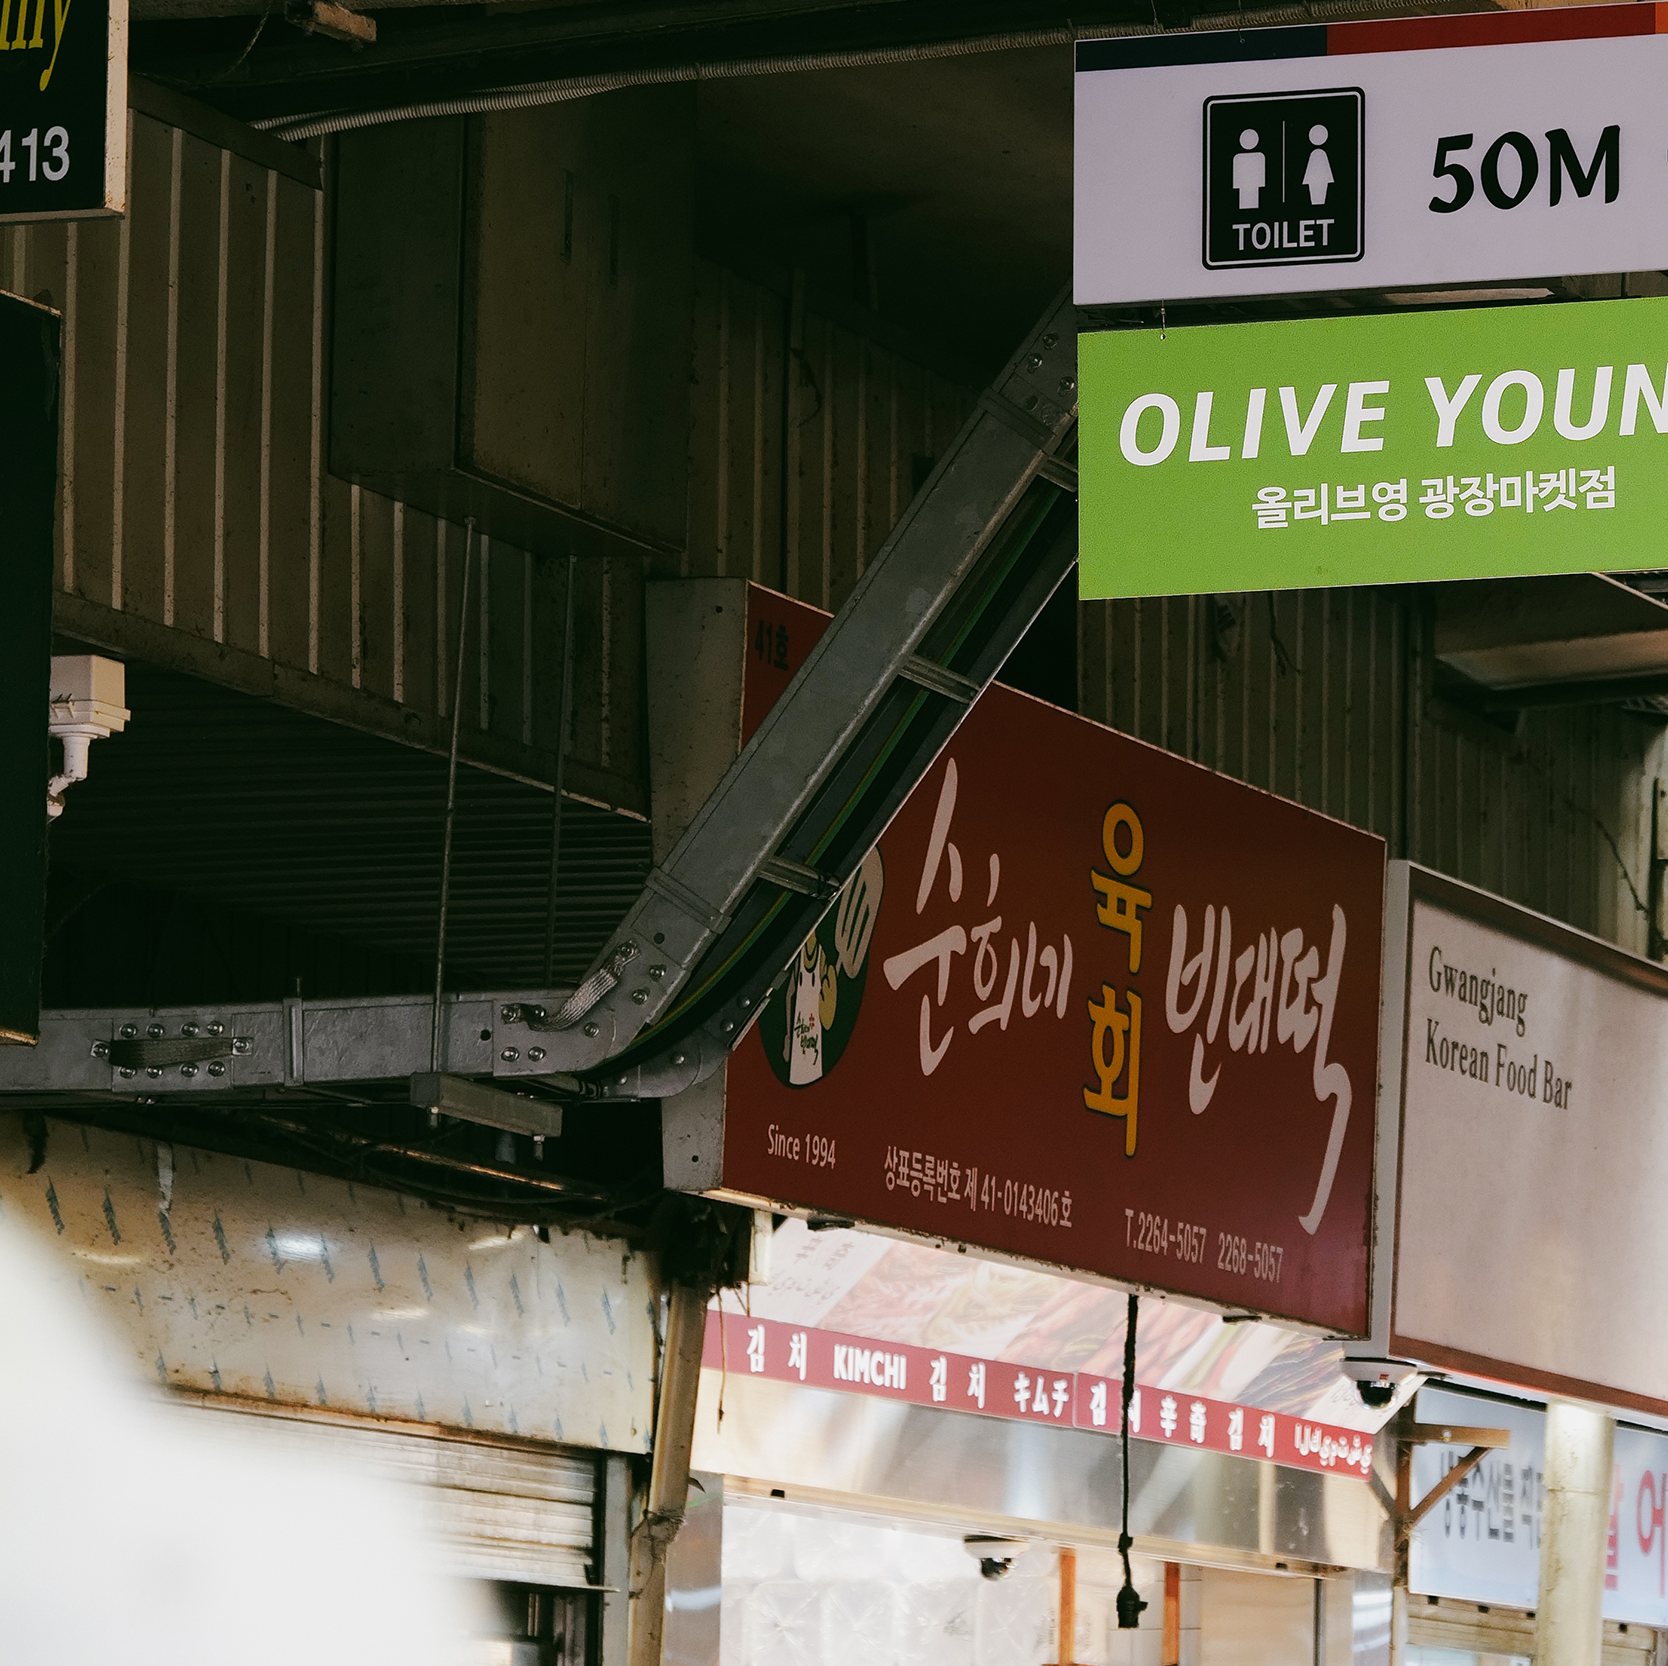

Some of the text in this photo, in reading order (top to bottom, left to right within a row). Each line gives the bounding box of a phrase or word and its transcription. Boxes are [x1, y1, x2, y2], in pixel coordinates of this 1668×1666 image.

[1429, 125, 1621, 214] 50M
[1232, 219, 1335, 251] TOILET
[1120, 379, 1390, 466] OLIVE
[1252, 465, 1617, 530] 올리브영 광장마켓점
[883, 757, 1352, 1235] 순희네 육회 빈대떡
[1429, 946, 1528, 1037] Gwangjang
[1425, 1018, 1573, 1110] Korean Food Bar
[768, 1124, 836, 1170] Since 1994
[884, 1145, 961, 1204] 상표등록번호
[964, 1167, 978, 1212] 제
[1125, 1208, 1284, 1283] T.2264-5057 2268-5057
[833, 1343, 907, 1390] KIMCHI
[1013, 1371, 1070, 1418] キムチ
